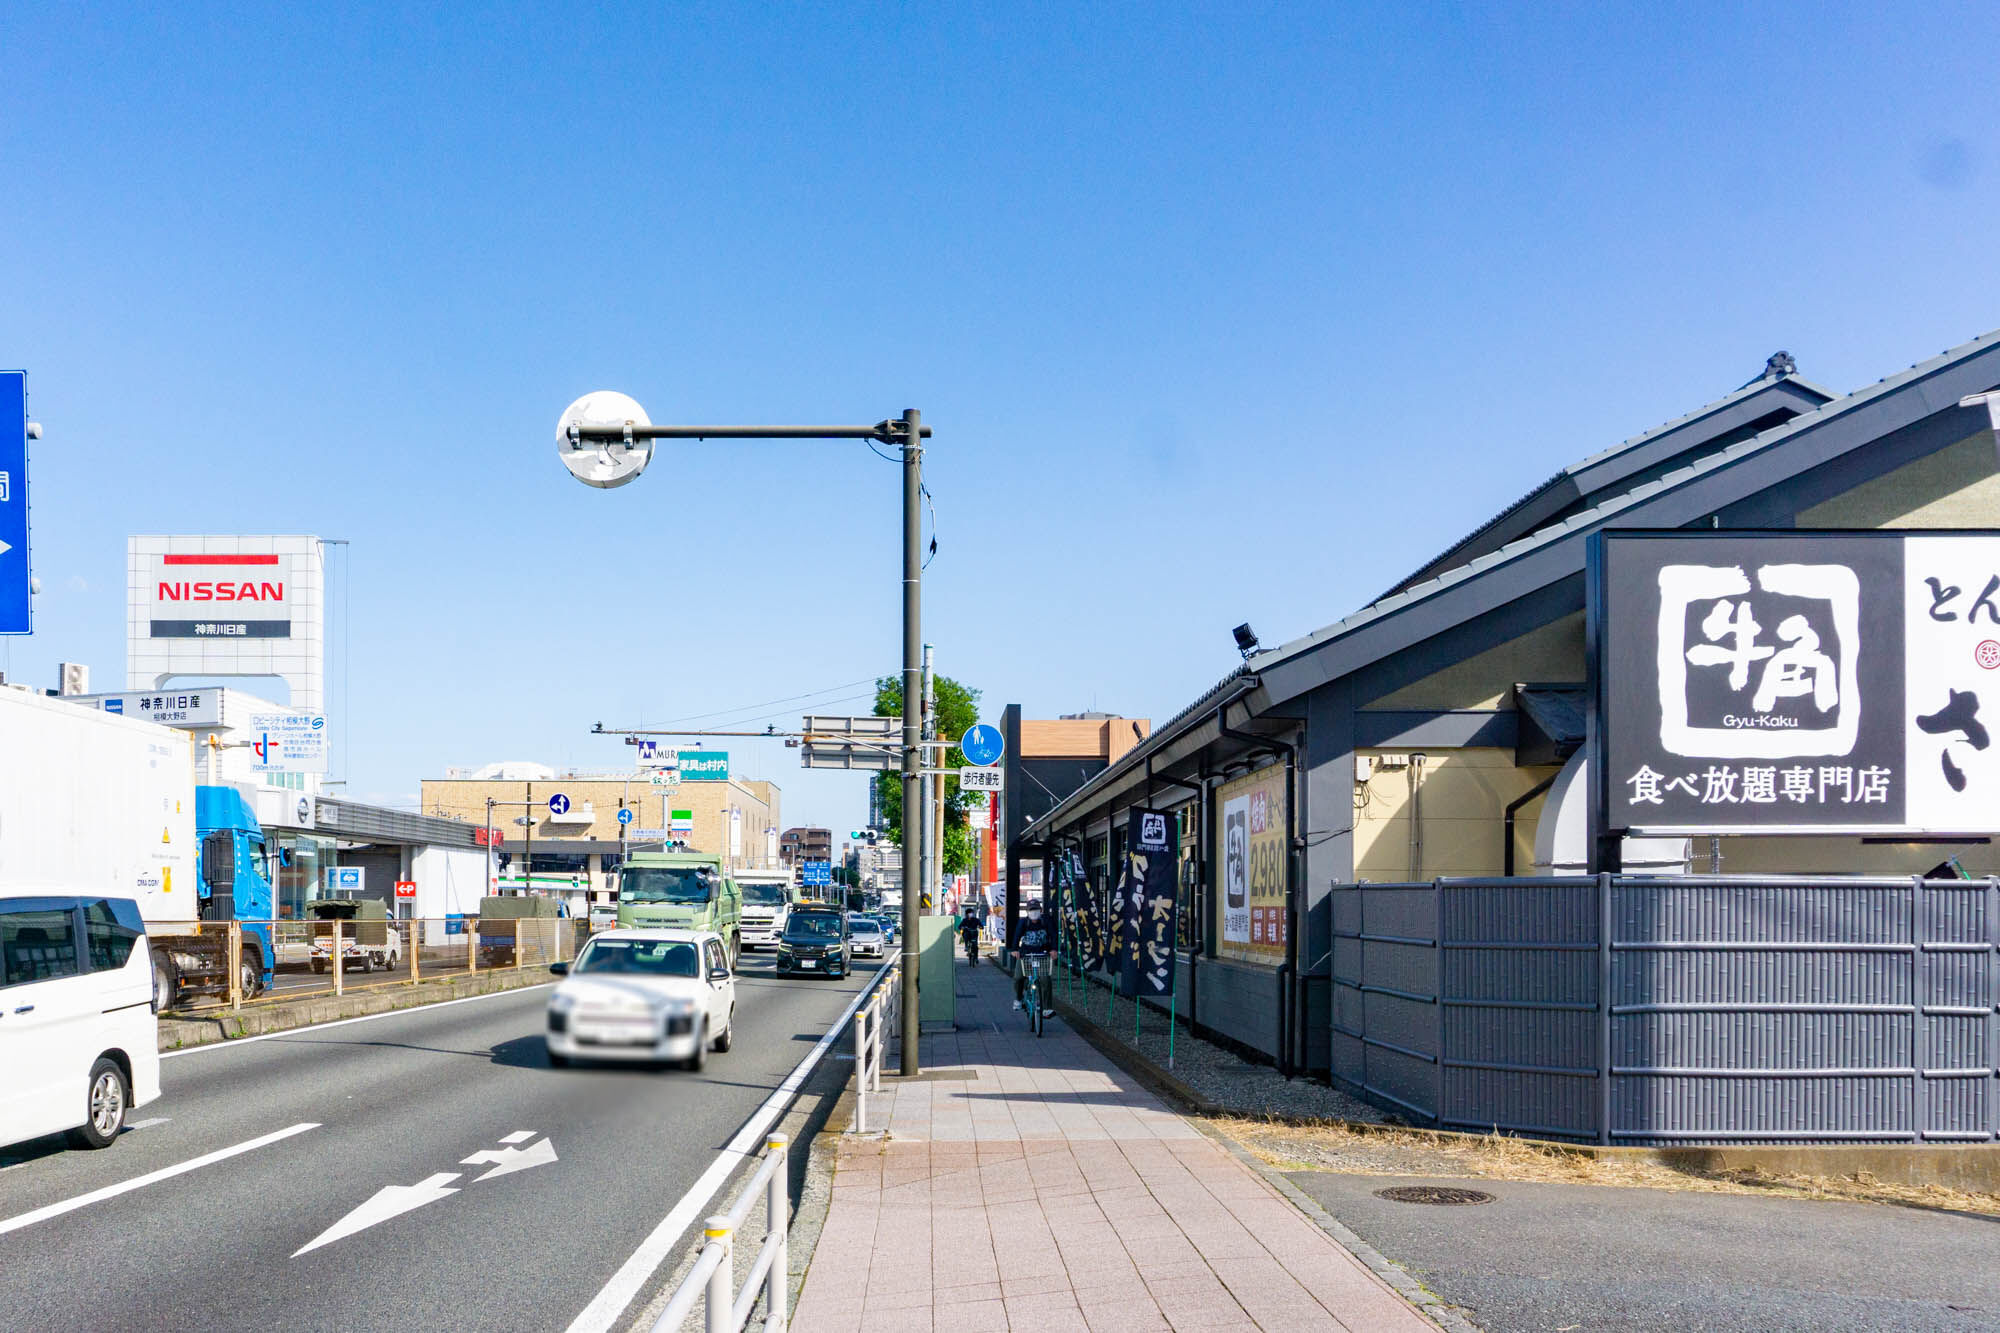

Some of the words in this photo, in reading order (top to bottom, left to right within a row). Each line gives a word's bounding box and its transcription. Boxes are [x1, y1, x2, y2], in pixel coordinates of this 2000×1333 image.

[158, 581, 284, 601] NISSAN
[194, 623, 247, 635] 神奈川日産
[1686, 600, 1839, 713] 牛角
[140, 695, 200, 710] 神奈川日産
[153, 712, 187, 721] 相模大野店
[1723, 714, 1798, 729] Gyu-Kaku
[679, 759, 728, 772] 家具は村内
[963, 773, 1000, 787] 歩行者優先
[1627, 765, 1892, 806] 食べ放題専門店
[407, 884, 415, 894] P
